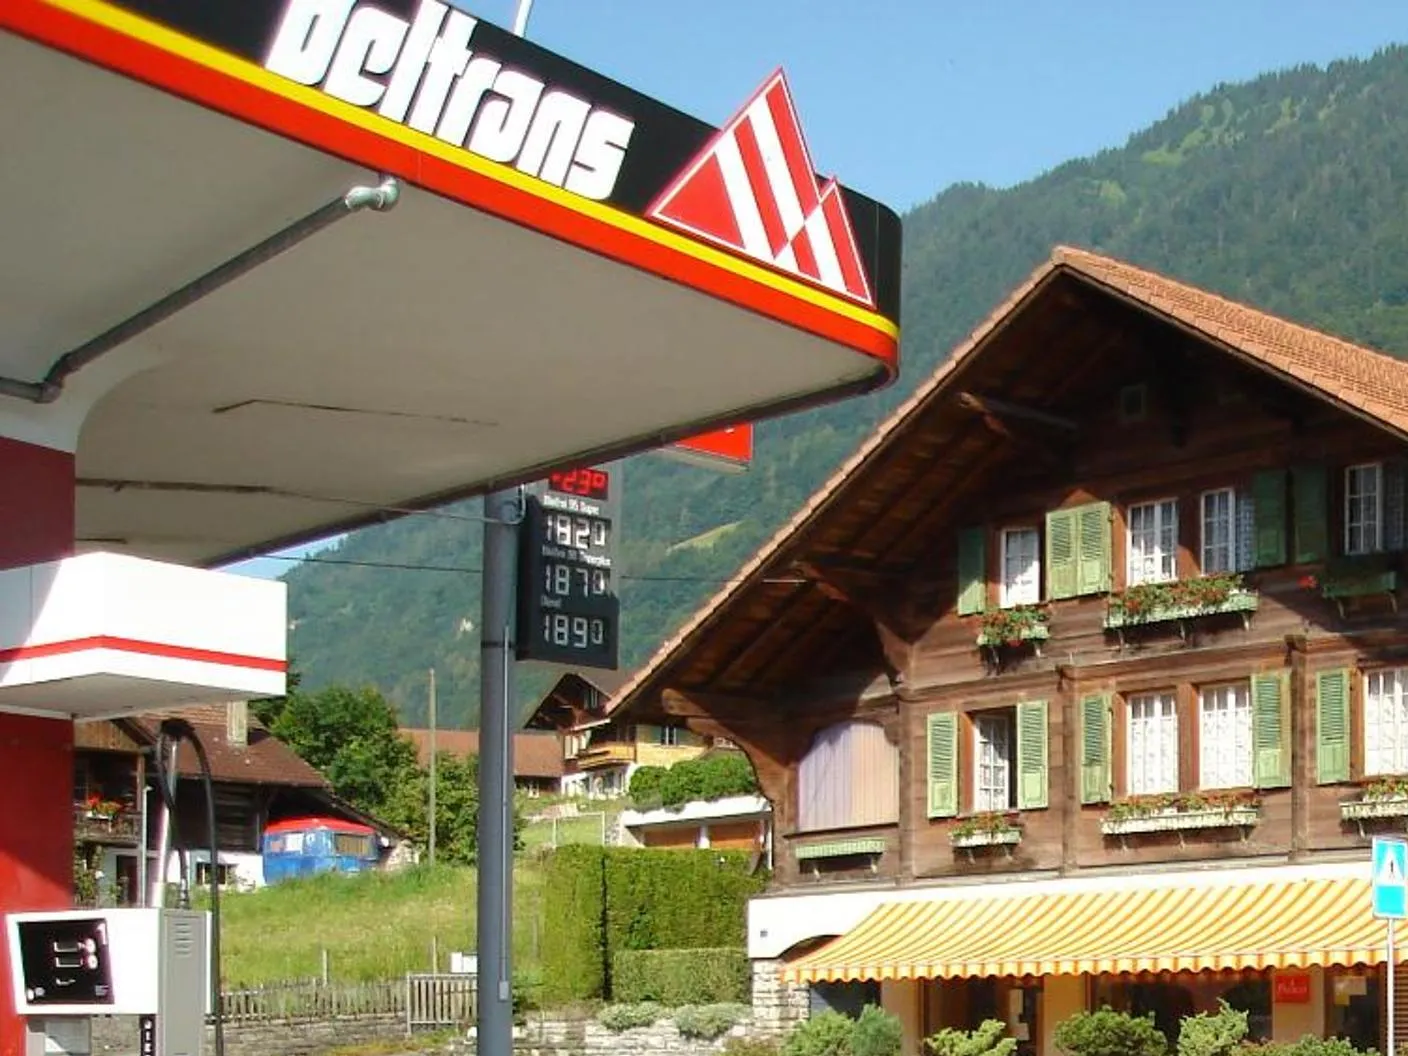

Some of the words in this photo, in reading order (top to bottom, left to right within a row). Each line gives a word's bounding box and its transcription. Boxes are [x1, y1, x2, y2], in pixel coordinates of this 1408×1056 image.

[547, 515, 606, 549] 1820
[545, 564, 605, 597] 1870
[543, 614, 604, 649] 1890
